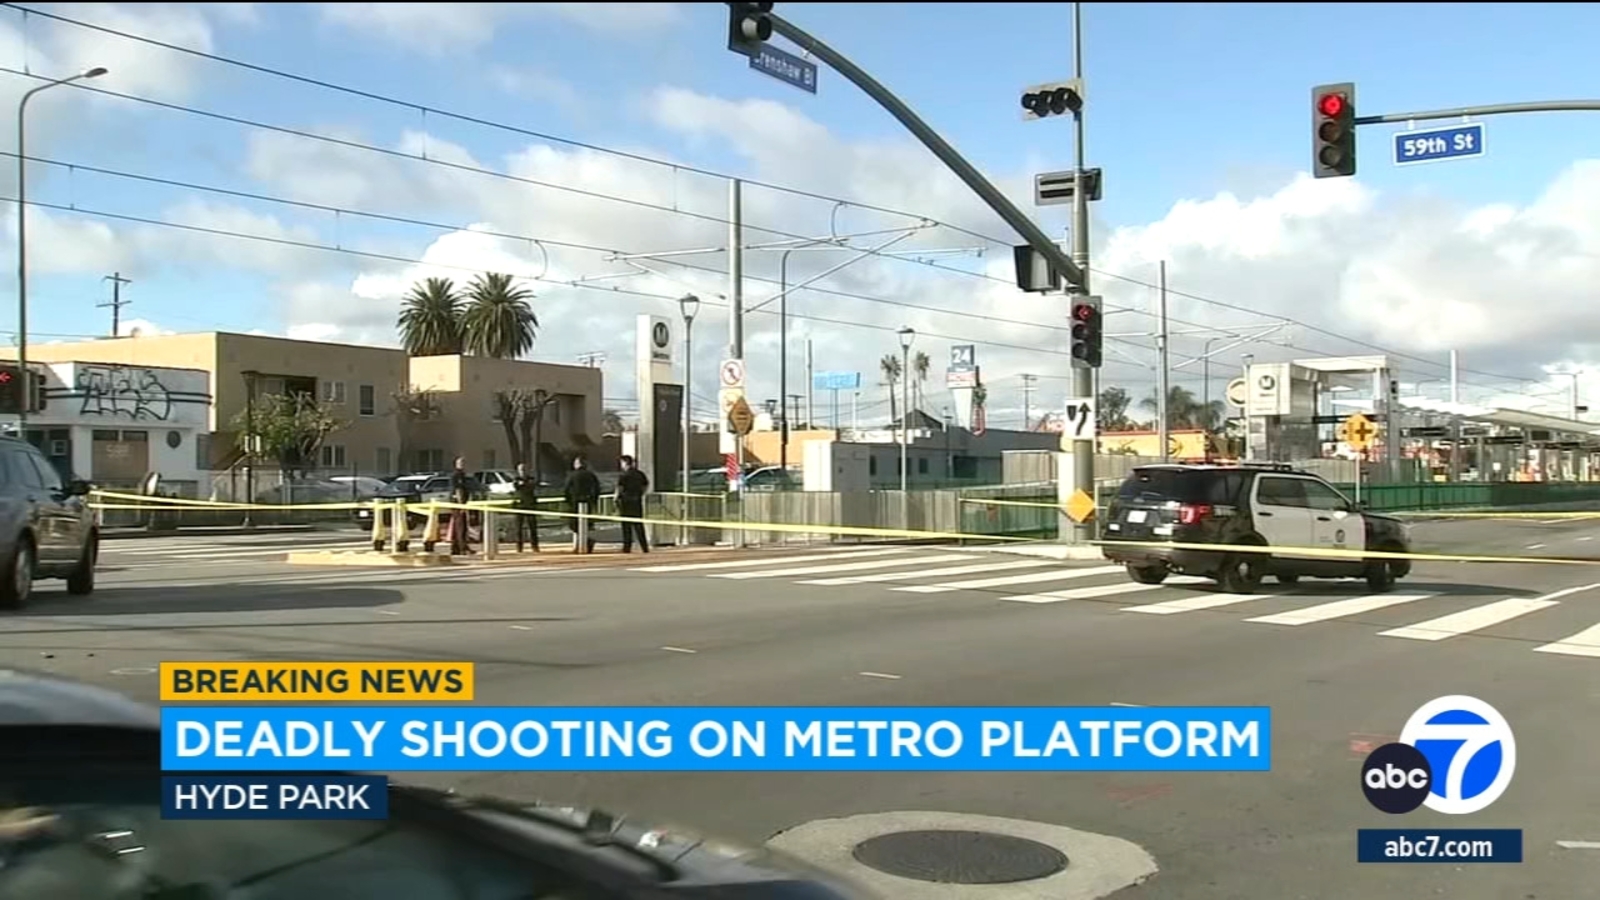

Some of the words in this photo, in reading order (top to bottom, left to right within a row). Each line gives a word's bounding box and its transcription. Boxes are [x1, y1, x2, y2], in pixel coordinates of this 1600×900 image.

[753, 52, 802, 81] renshaw
[1404, 137, 1447, 158] 59th
[1454, 132, 1475, 151] St
[952, 348, 971, 364] 24
